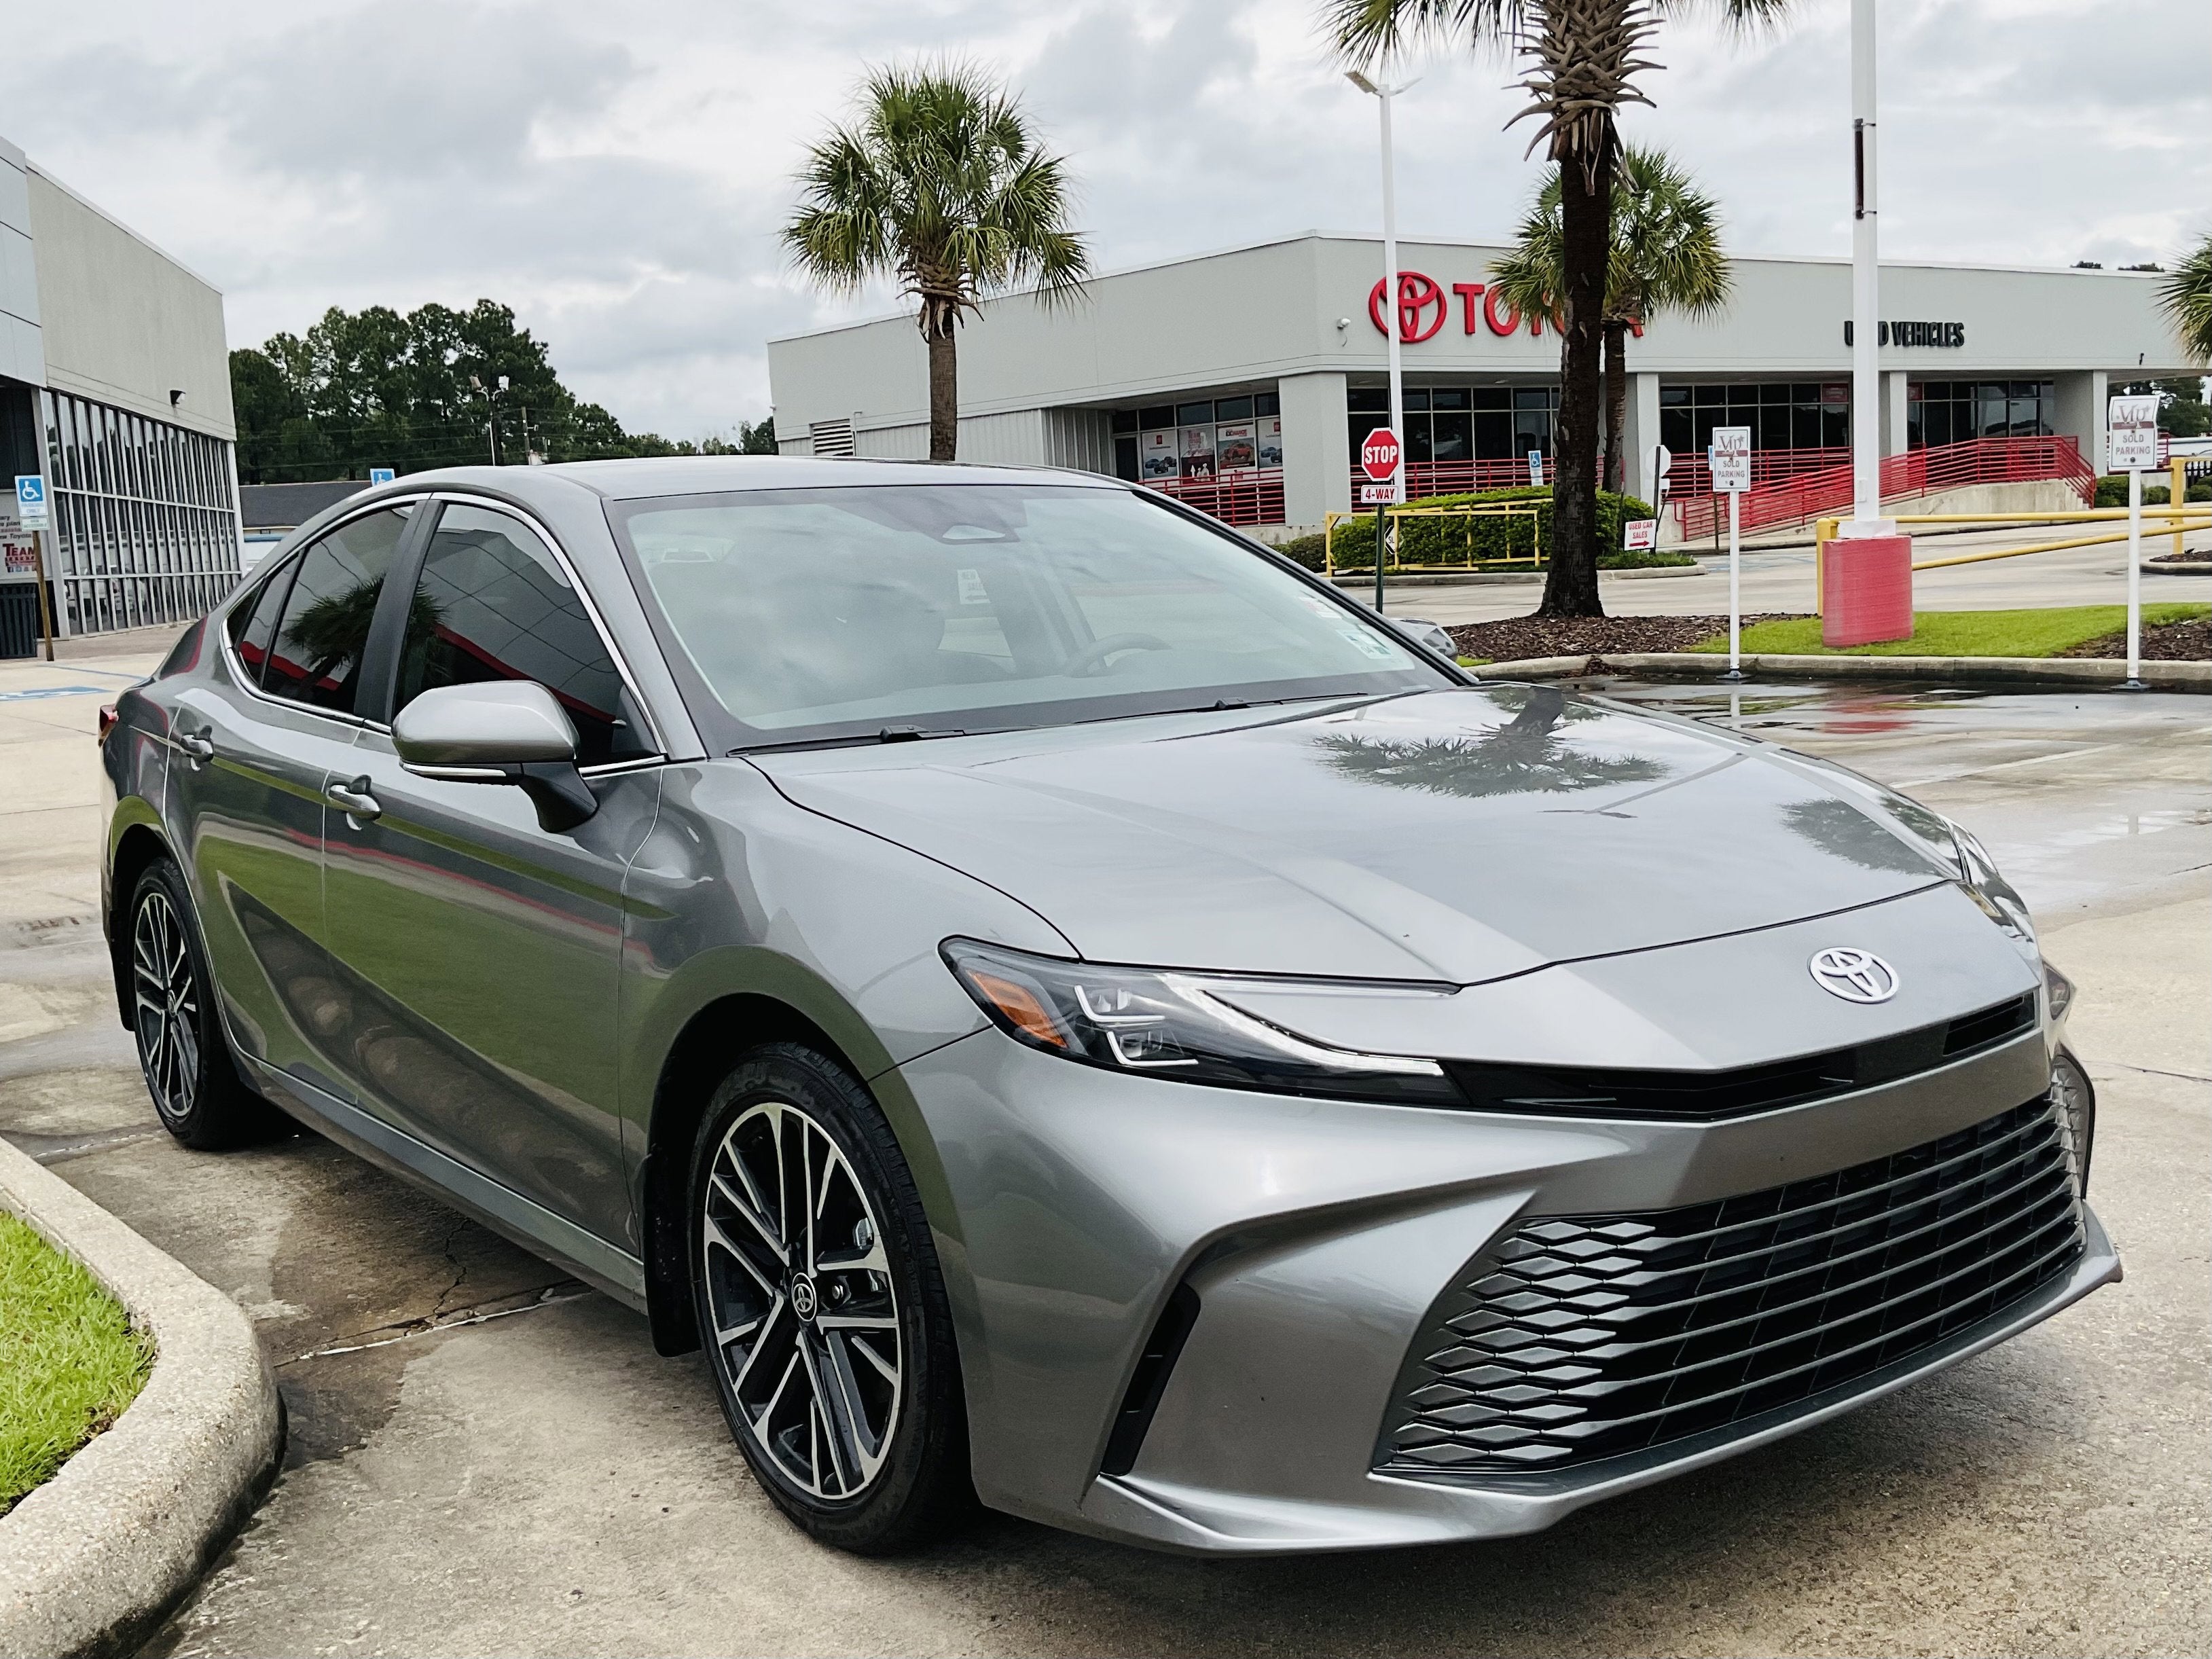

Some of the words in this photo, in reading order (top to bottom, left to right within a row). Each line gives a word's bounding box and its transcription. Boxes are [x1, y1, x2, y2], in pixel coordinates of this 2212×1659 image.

[1844, 321, 1889, 346] UD
[1891, 321, 1965, 347] VEHICLES
[2123, 435, 2144, 443] SOLD
[1364, 445, 1398, 464] STOP
[2116, 446, 2150, 455] PARKING
[1365, 488, 1395, 499] 4-WAY
[1629, 522, 1641, 530] USED
